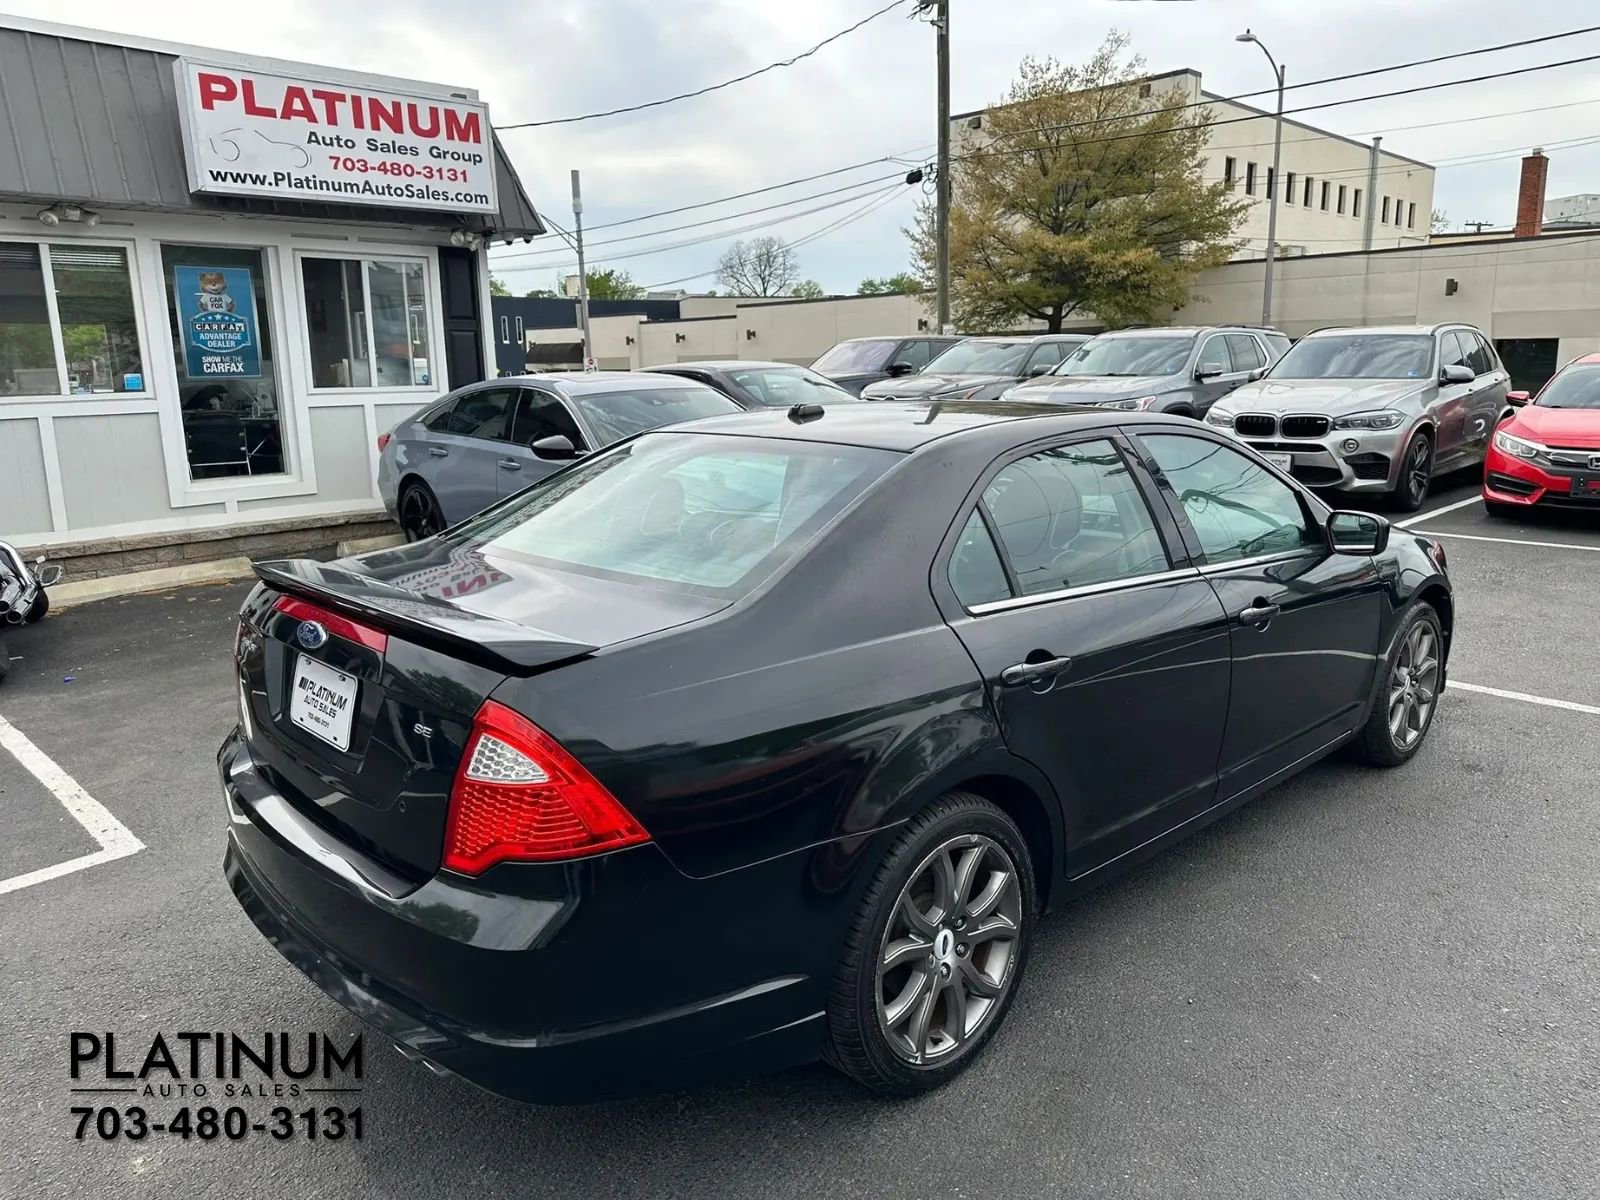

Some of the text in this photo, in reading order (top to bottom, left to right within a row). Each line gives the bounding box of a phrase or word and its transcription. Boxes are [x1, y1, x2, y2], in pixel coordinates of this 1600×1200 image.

[198, 72, 482, 144] PLATINUM
[306, 131, 483, 165] Auto Sales Group
[328, 155, 468, 183] 703-480-3131
[208, 169, 489, 205] www.PlatinumAutoSales.com
[195, 322, 245, 331] CARFAX
[207, 340, 236, 348] DEALER
[203, 362, 245, 373] CARFAX
[299, 623, 317, 642] Ford
[304, 694, 337, 718] AUTO SALES
[306, 680, 348, 711] PLATINUM
[413, 723, 433, 738] SE
